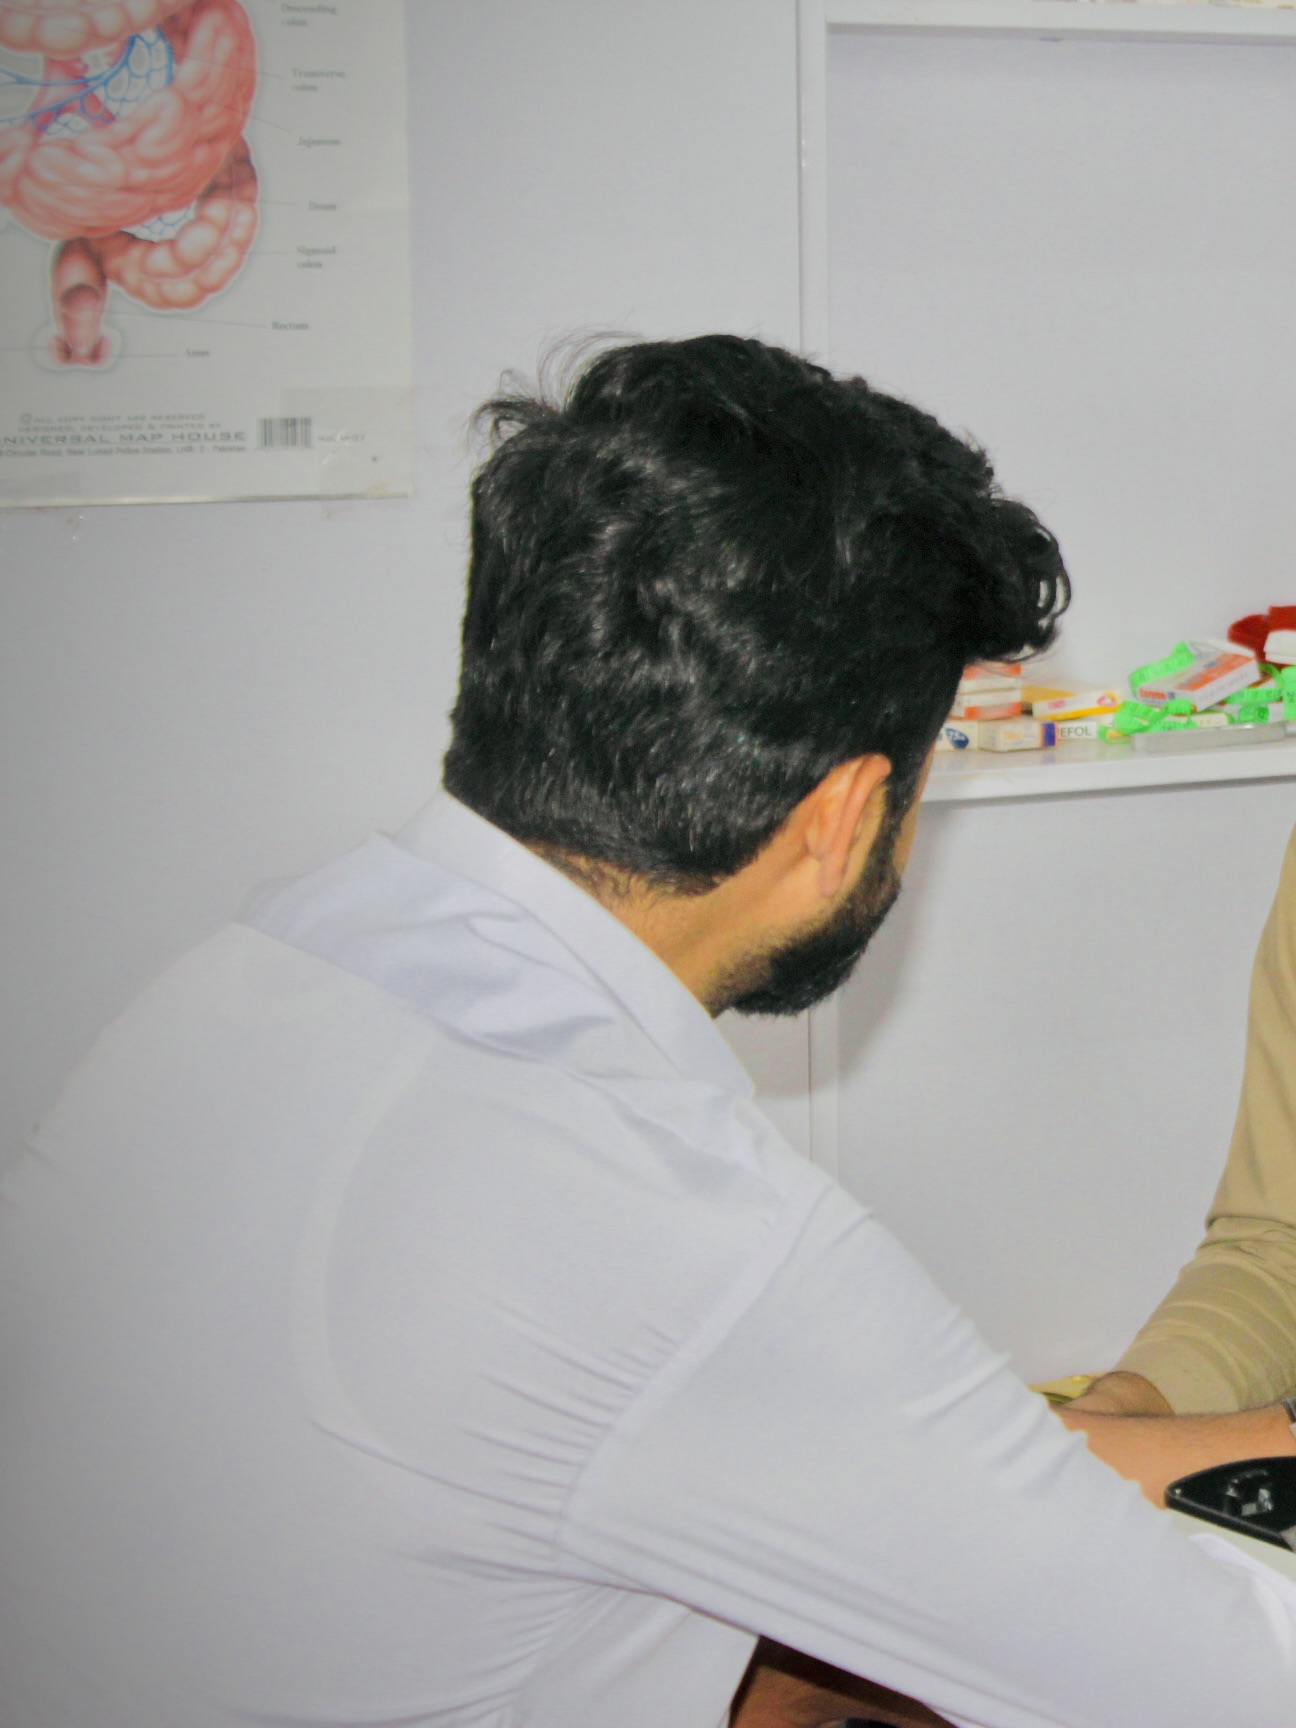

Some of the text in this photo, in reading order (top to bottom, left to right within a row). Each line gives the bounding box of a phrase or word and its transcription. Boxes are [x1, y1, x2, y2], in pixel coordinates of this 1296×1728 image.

[296, 245, 337, 257] Sigmoid
[271, 320, 310, 331] Rectum
[119, 432, 163, 443] MAP
[172, 431, 247, 442] HOUSE
